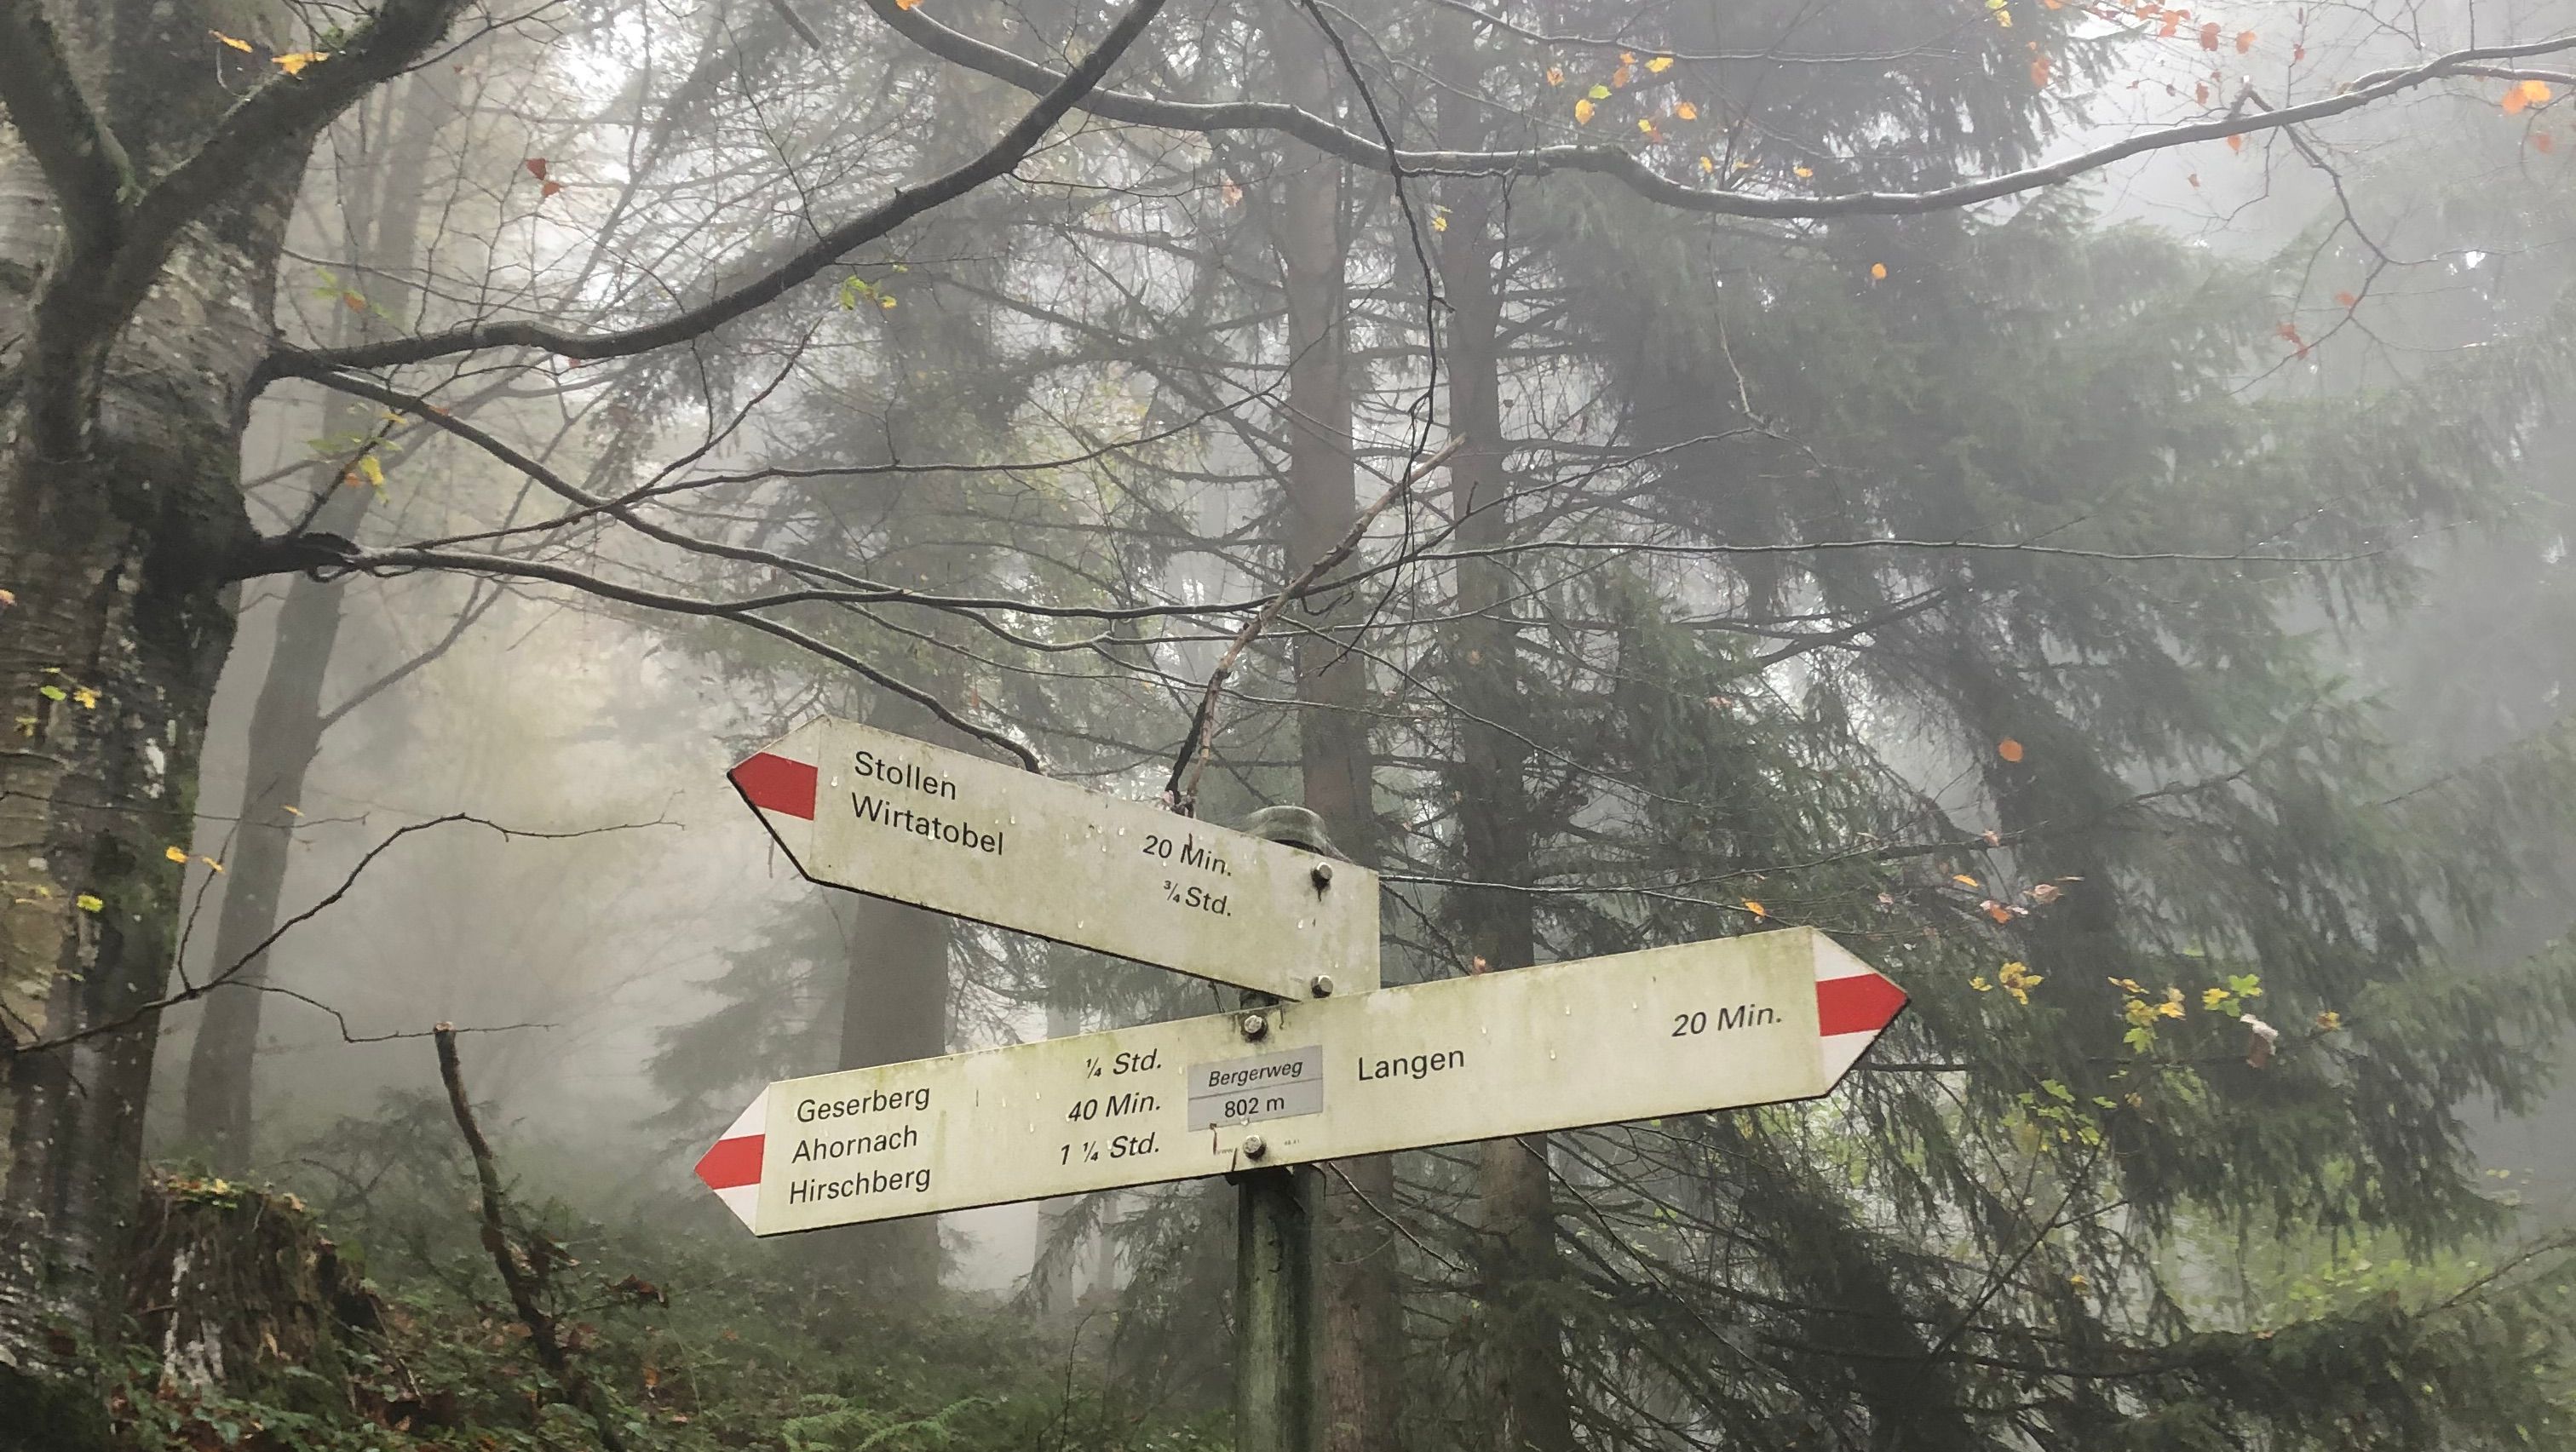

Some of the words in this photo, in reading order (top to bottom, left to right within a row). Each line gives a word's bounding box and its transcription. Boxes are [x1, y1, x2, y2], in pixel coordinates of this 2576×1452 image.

[854, 750, 957, 801] Stollen
[851, 791, 1003, 856] Wirtatobel
[1142, 835, 1173, 859] 20
[1180, 843, 1232, 876] Min.
[1185, 886, 1231, 916] Std.
[1671, 1011, 1707, 1037] 20
[1717, 1003, 1782, 1031] Min.
[1113, 1047, 1162, 1075] Std.
[1208, 1061, 1303, 1088] Bergerweg
[1358, 1049, 1464, 1082] Langen
[796, 1088, 930, 1122] Geserberg
[1068, 1099, 1098, 1122] 40
[1106, 1092, 1160, 1117] Min.
[1224, 1097, 1259, 1118] 802
[1266, 1096, 1285, 1112] m
[791, 1125, 918, 1164] Ahornach
[1061, 1144, 1071, 1166] 1
[1110, 1132, 1159, 1159] Std.
[789, 1168, 931, 1205] Hirschberg
